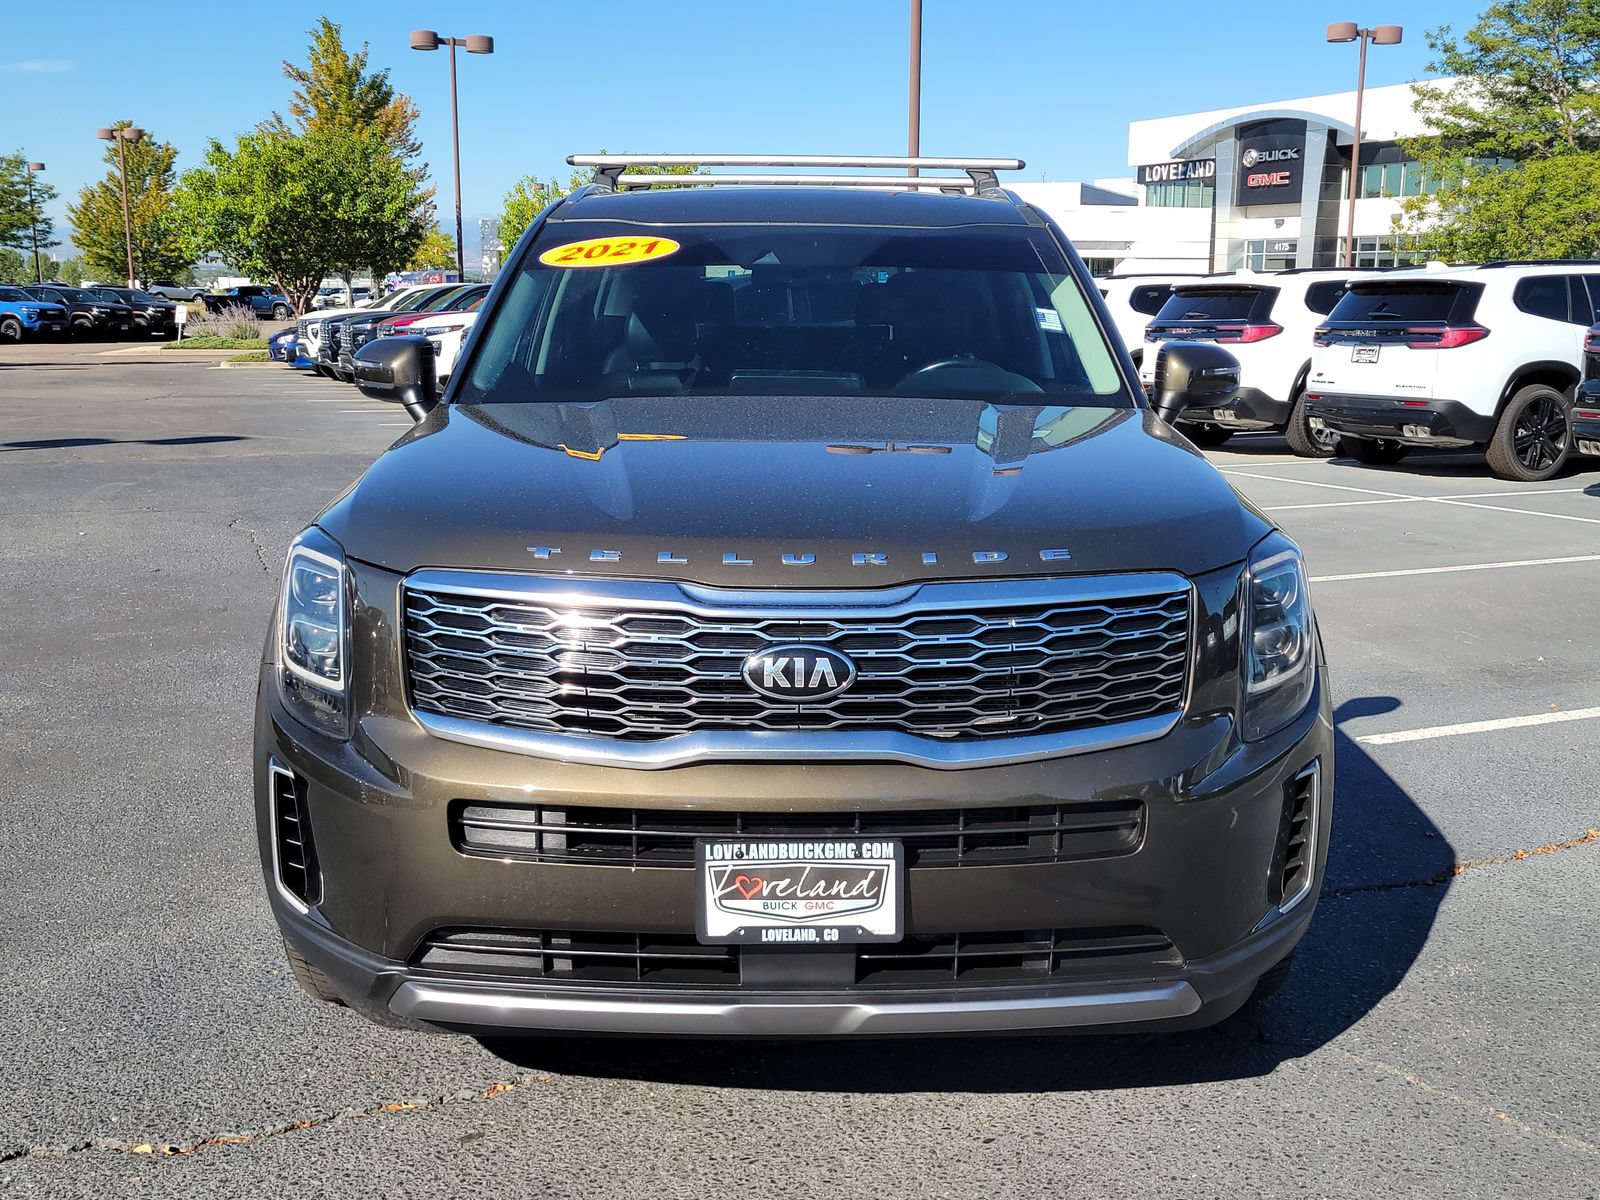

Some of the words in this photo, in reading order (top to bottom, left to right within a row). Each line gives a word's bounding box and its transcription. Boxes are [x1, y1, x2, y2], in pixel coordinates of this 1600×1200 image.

[1257, 148, 1300, 162] BUICK
[1145, 160, 1215, 182] LOVELAND
[1247, 171, 1290, 187] GMC
[555, 240, 660, 262] 2021
[1273, 242, 1290, 251] 4175
[526, 546, 1072, 566] TELLURIDE
[762, 657, 838, 688] KIA
[704, 842, 894, 861] LOVELANDBUICKGMCCOM
[762, 901, 798, 911] BUICK
[804, 901, 835, 911] GMC
[761, 928, 821, 943] LOVELAND,
[823, 928, 840, 942] CO
